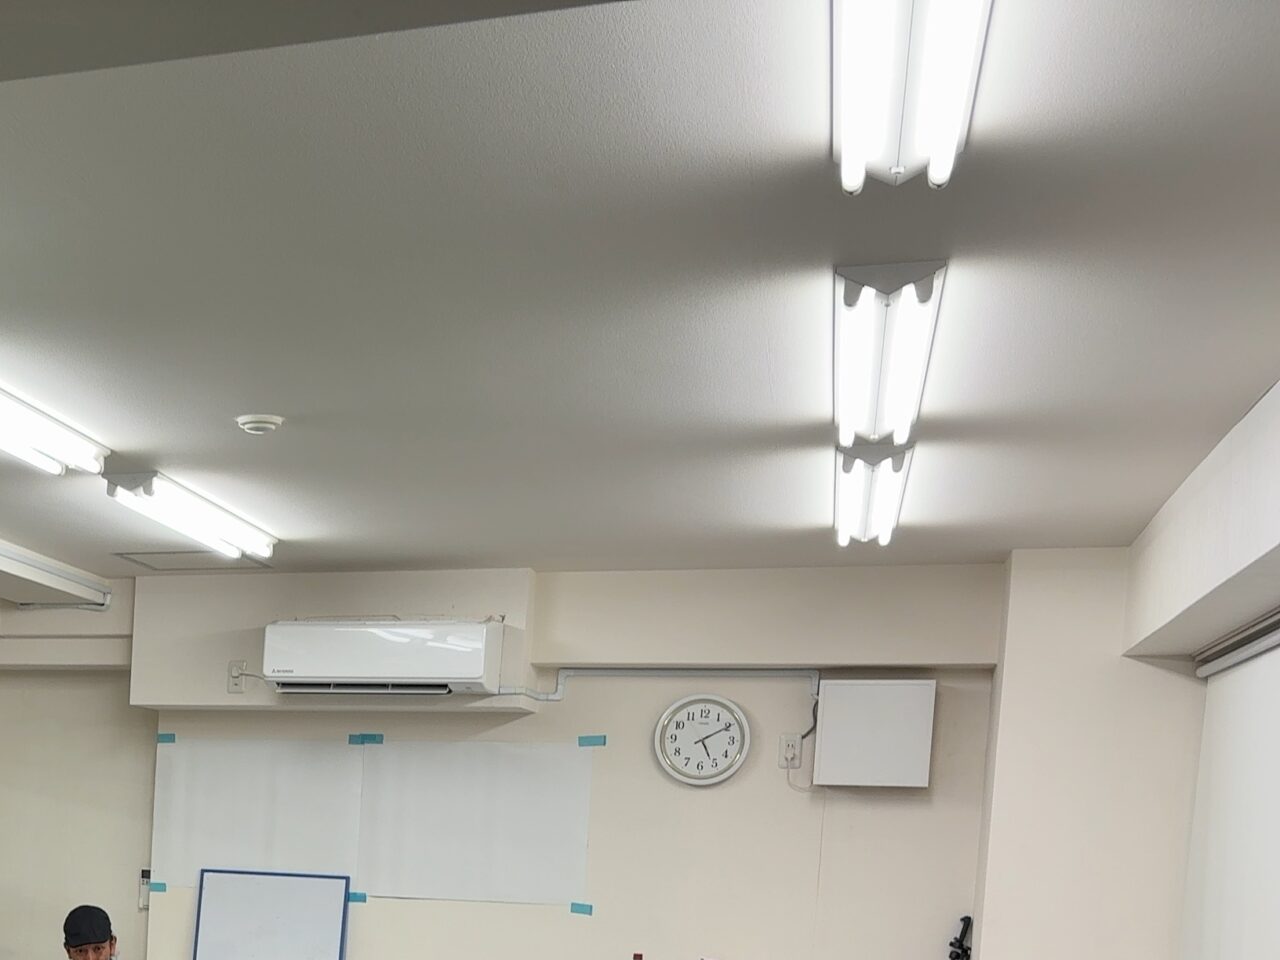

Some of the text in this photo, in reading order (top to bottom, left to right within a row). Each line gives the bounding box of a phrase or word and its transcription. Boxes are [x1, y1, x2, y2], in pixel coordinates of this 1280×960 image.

[686, 711, 695, 721] 11
[700, 708, 710, 719] 12
[716, 712, 721, 722] 1
[675, 720, 685, 730] 10
[724, 721, 732, 732] 2
[670, 734, 677, 744] 9
[727, 736, 735, 746] 3
[673, 747, 681, 757] 8
[722, 749, 729, 759] 4
[684, 757, 691, 767] 7
[696, 761, 704, 771] 6
[711, 758, 718, 768] 5
